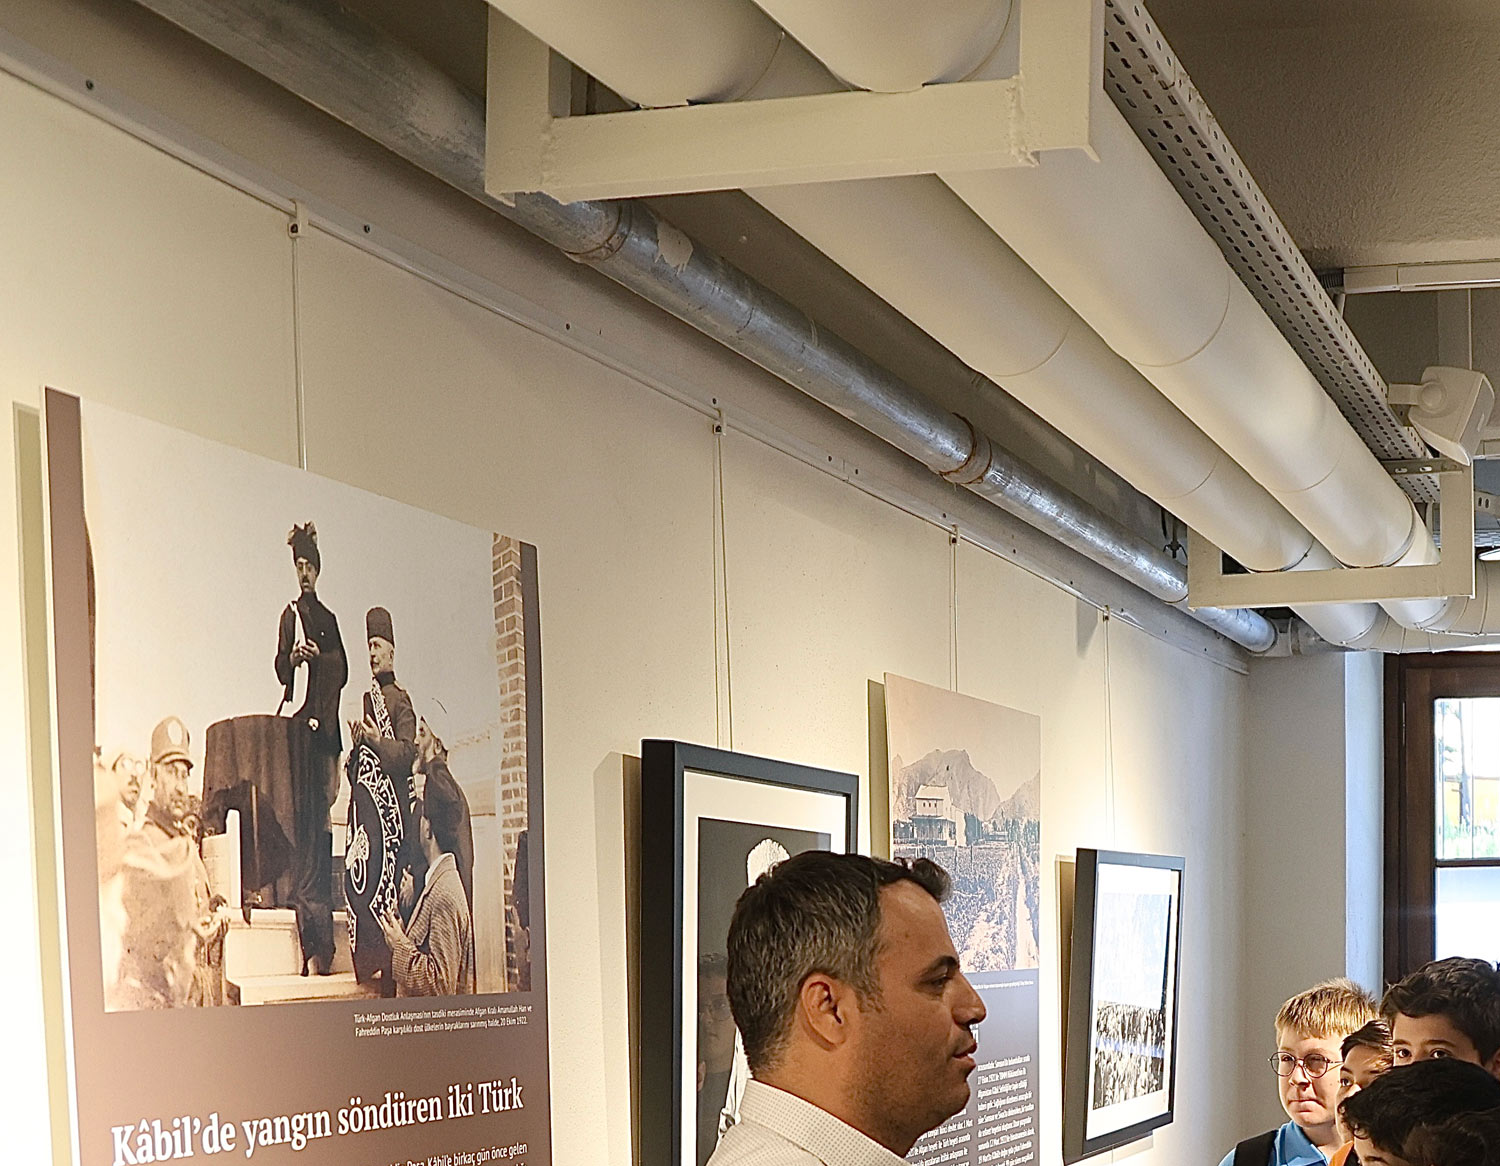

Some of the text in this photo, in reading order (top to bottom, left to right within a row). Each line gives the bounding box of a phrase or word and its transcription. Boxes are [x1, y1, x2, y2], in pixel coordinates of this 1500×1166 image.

[110, 1076, 524, 1166] Kâbil'de yangın söndüren iki Türk
[452, 1150, 476, 1166] birkaç
[475, 1147, 491, 1166] gün
[490, 1145, 508, 1160] önce
[507, 1140, 528, 1160] gelen
